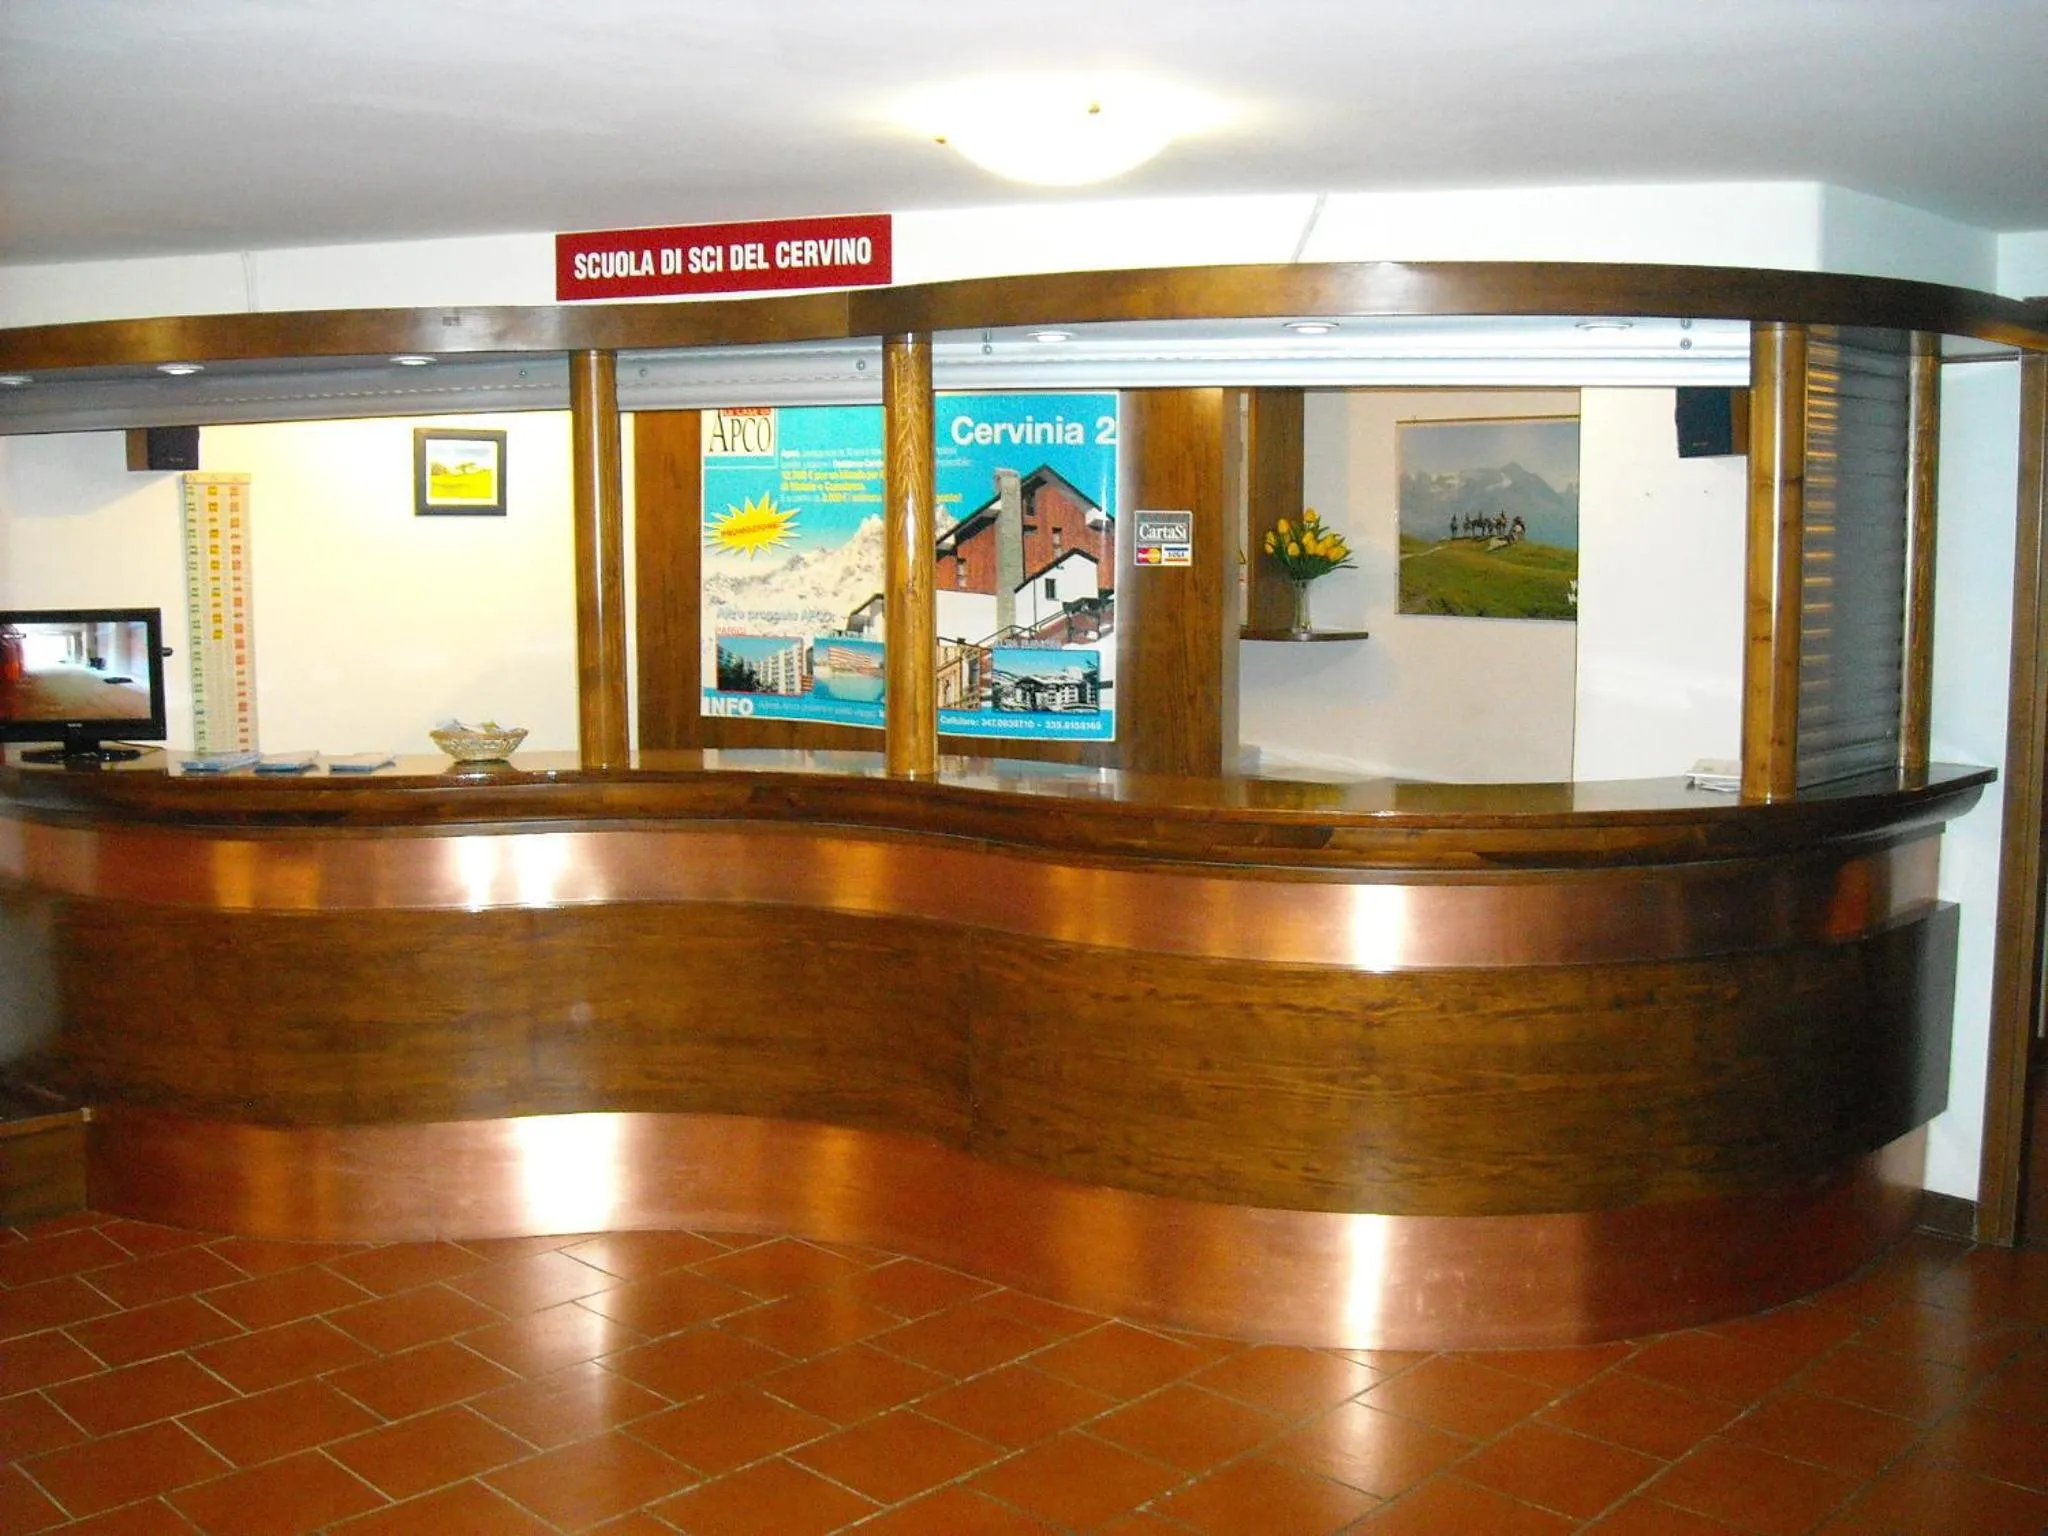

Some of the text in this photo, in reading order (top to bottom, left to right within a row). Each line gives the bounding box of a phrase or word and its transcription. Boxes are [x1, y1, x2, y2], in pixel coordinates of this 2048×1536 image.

[574, 236, 872, 280] SCUOLA DI SCI DEL CERVINO
[709, 408, 772, 452] APCO
[951, 415, 1085, 446] Cervinia
[702, 696, 754, 716] INFO
